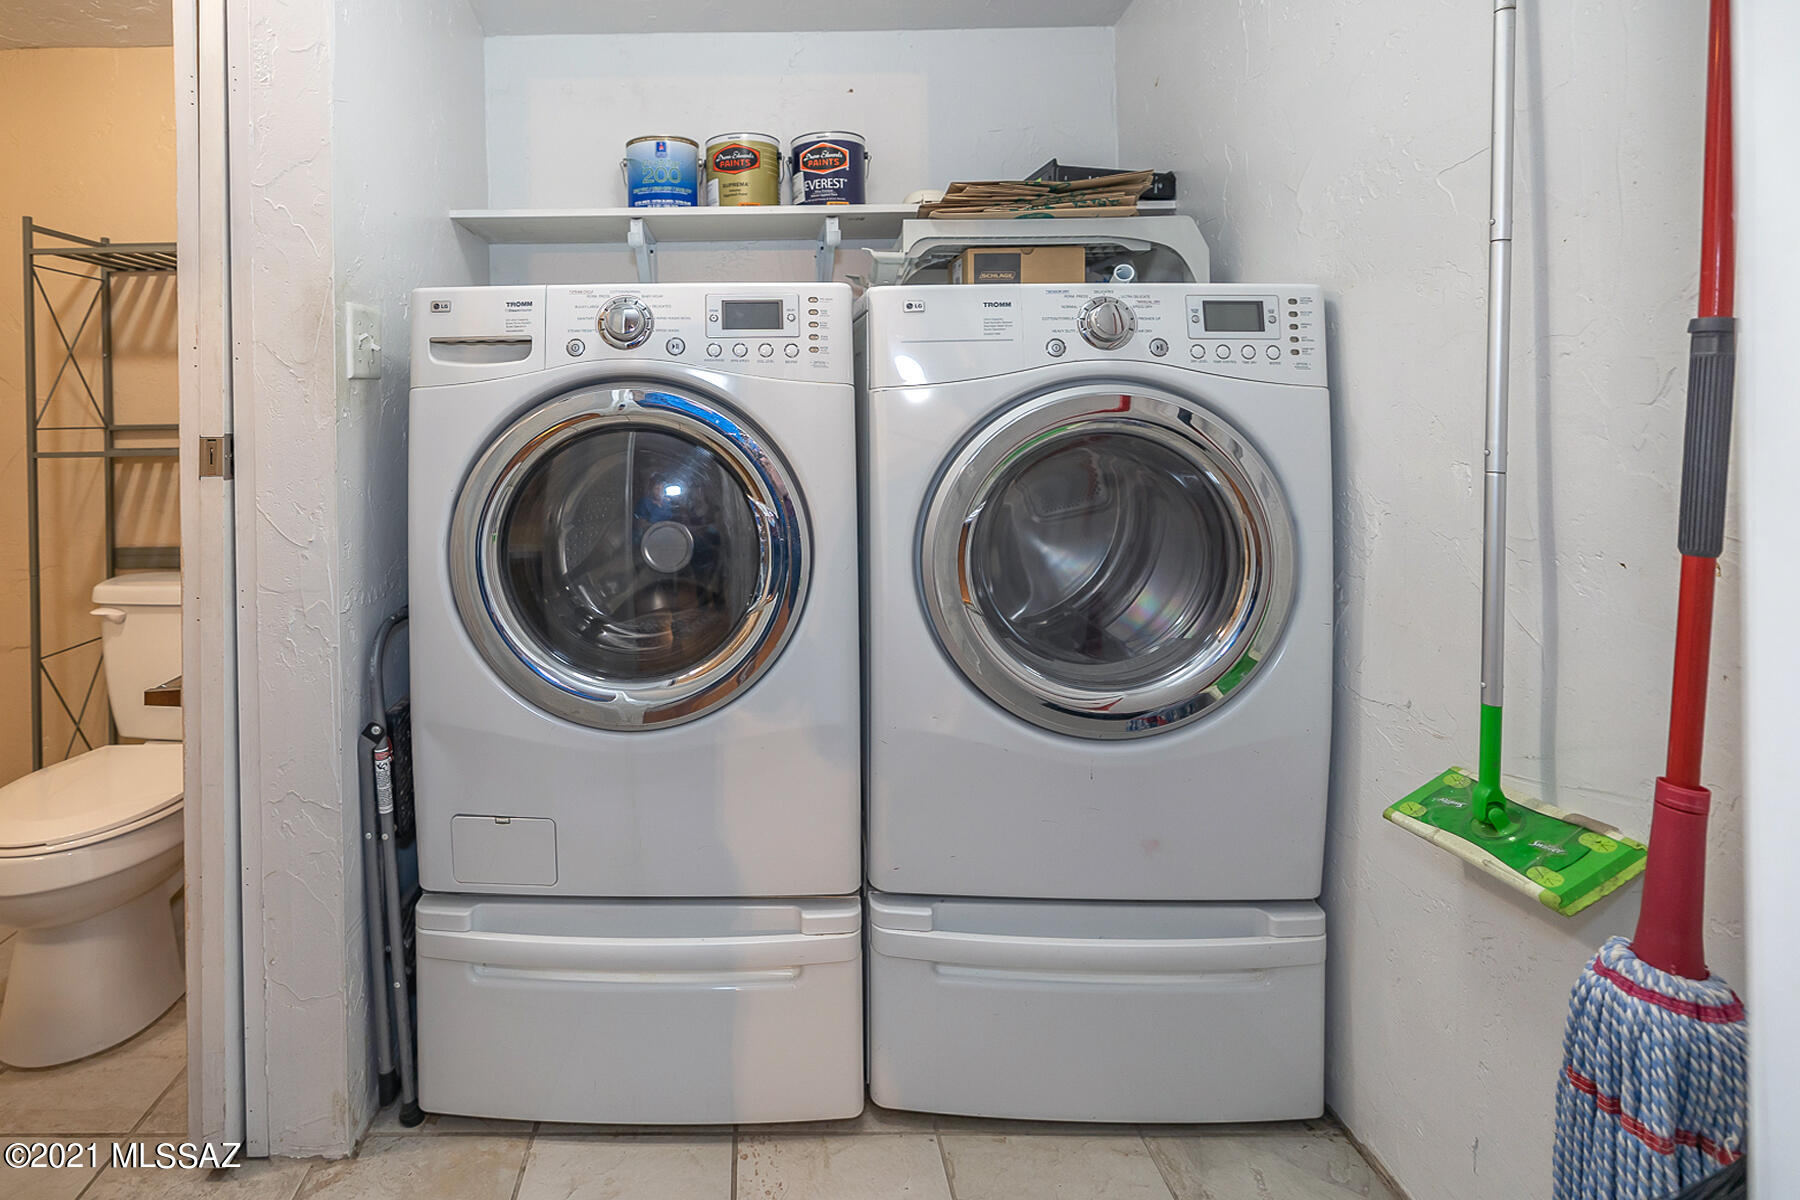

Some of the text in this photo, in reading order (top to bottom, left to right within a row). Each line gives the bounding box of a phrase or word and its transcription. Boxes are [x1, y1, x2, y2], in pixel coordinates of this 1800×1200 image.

[720, 158, 751, 168] PAINTS
[807, 158, 840, 167] PAINTS
[642, 166, 681, 183] 200
